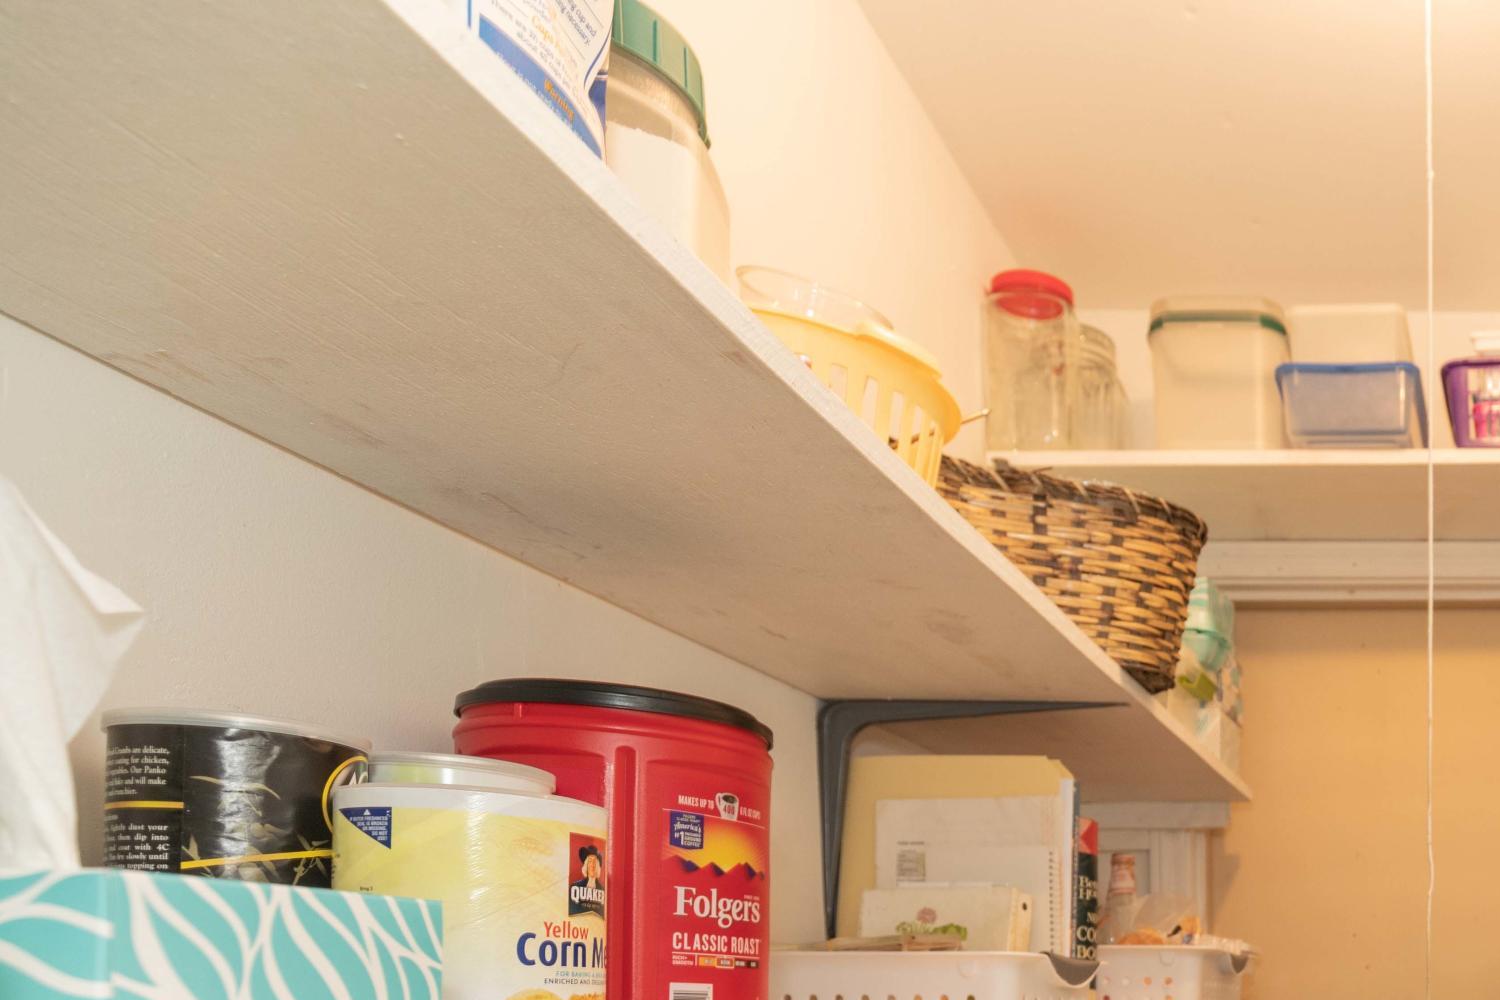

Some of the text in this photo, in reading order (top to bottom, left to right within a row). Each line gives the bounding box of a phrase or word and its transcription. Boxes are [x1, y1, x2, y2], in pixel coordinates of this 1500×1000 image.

[142, 745, 171, 755] delicate,
[140, 756, 171, 765] chicken,
[144, 766, 167, 774] Panko
[147, 777, 167, 785] make
[678, 795, 699, 808] MAKES
[128, 823, 145, 831] dust
[134, 834, 148, 842] dip
[148, 852, 169, 860] until
[672, 885, 761, 929] Folgers
[544, 920, 589, 940] Yellow
[672, 931, 760, 955] CLASSIC ROAST
[516, 932, 586, 967] Corn
[544, 977, 578, 985] ENRICHED
